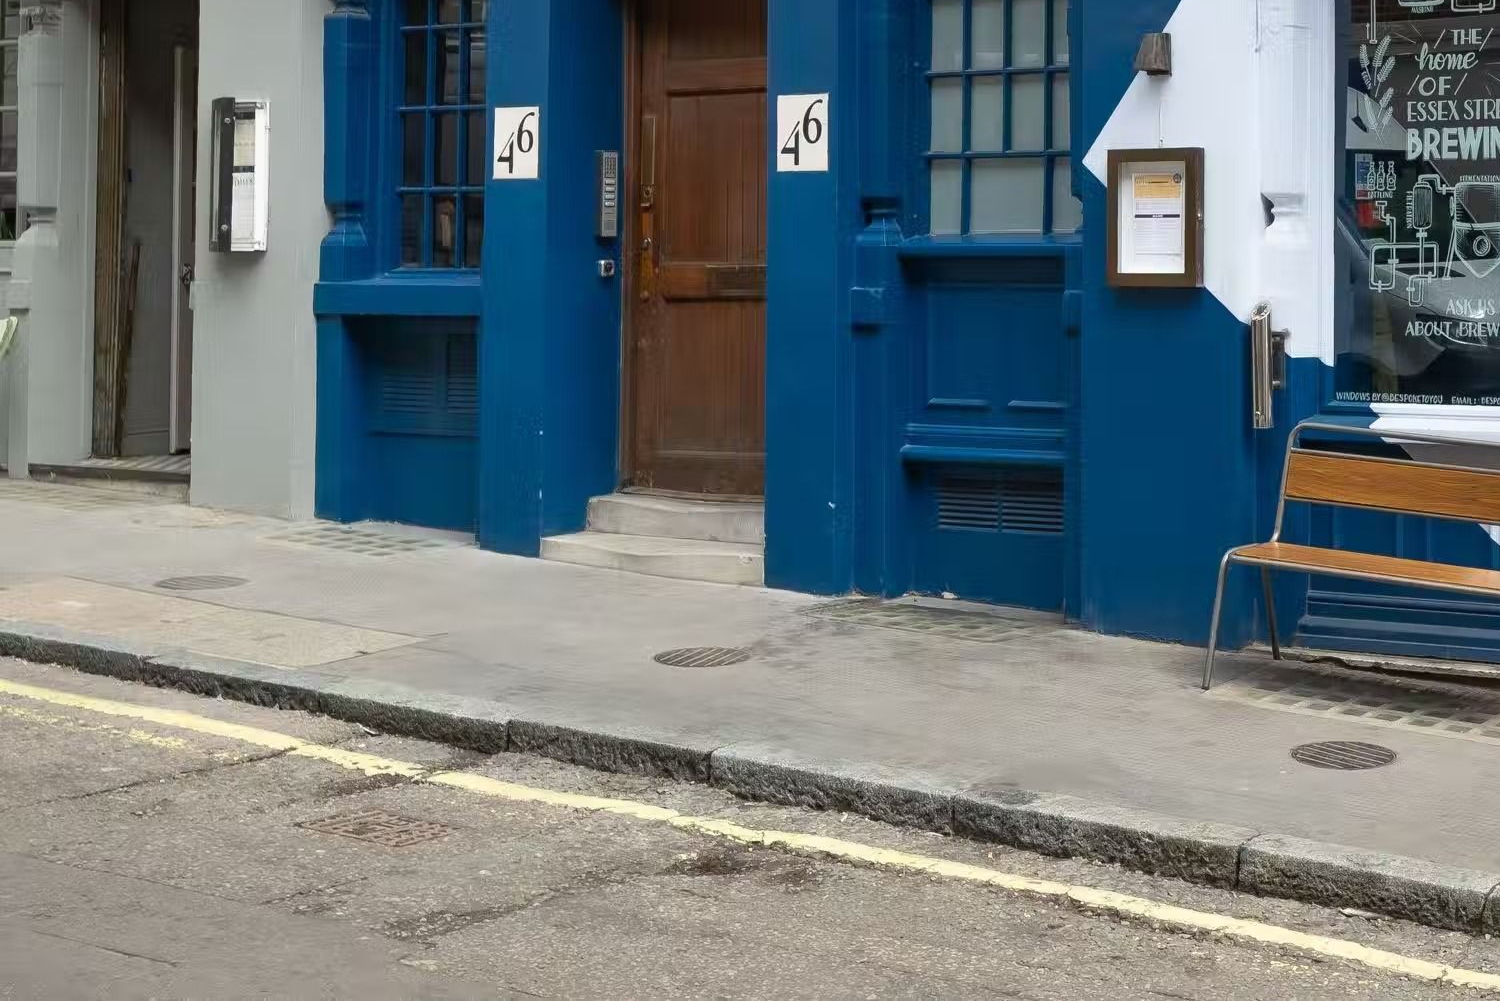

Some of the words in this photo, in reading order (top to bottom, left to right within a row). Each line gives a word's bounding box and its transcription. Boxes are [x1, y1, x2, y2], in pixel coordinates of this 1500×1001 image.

[1451, 28, 1482, 45] THE
[1415, 42, 1479, 71] home
[1418, 77, 1451, 95] OF
[1407, 100, 1460, 122] ESSEX
[781, 99, 824, 166] 46
[497, 111, 536, 174] 46
[1446, 299, 1477, 316] ASK
[1478, 299, 1495, 316] US
[1405, 321, 1453, 338] ABOUT
[1336, 391, 1370, 401] WINDOWS
